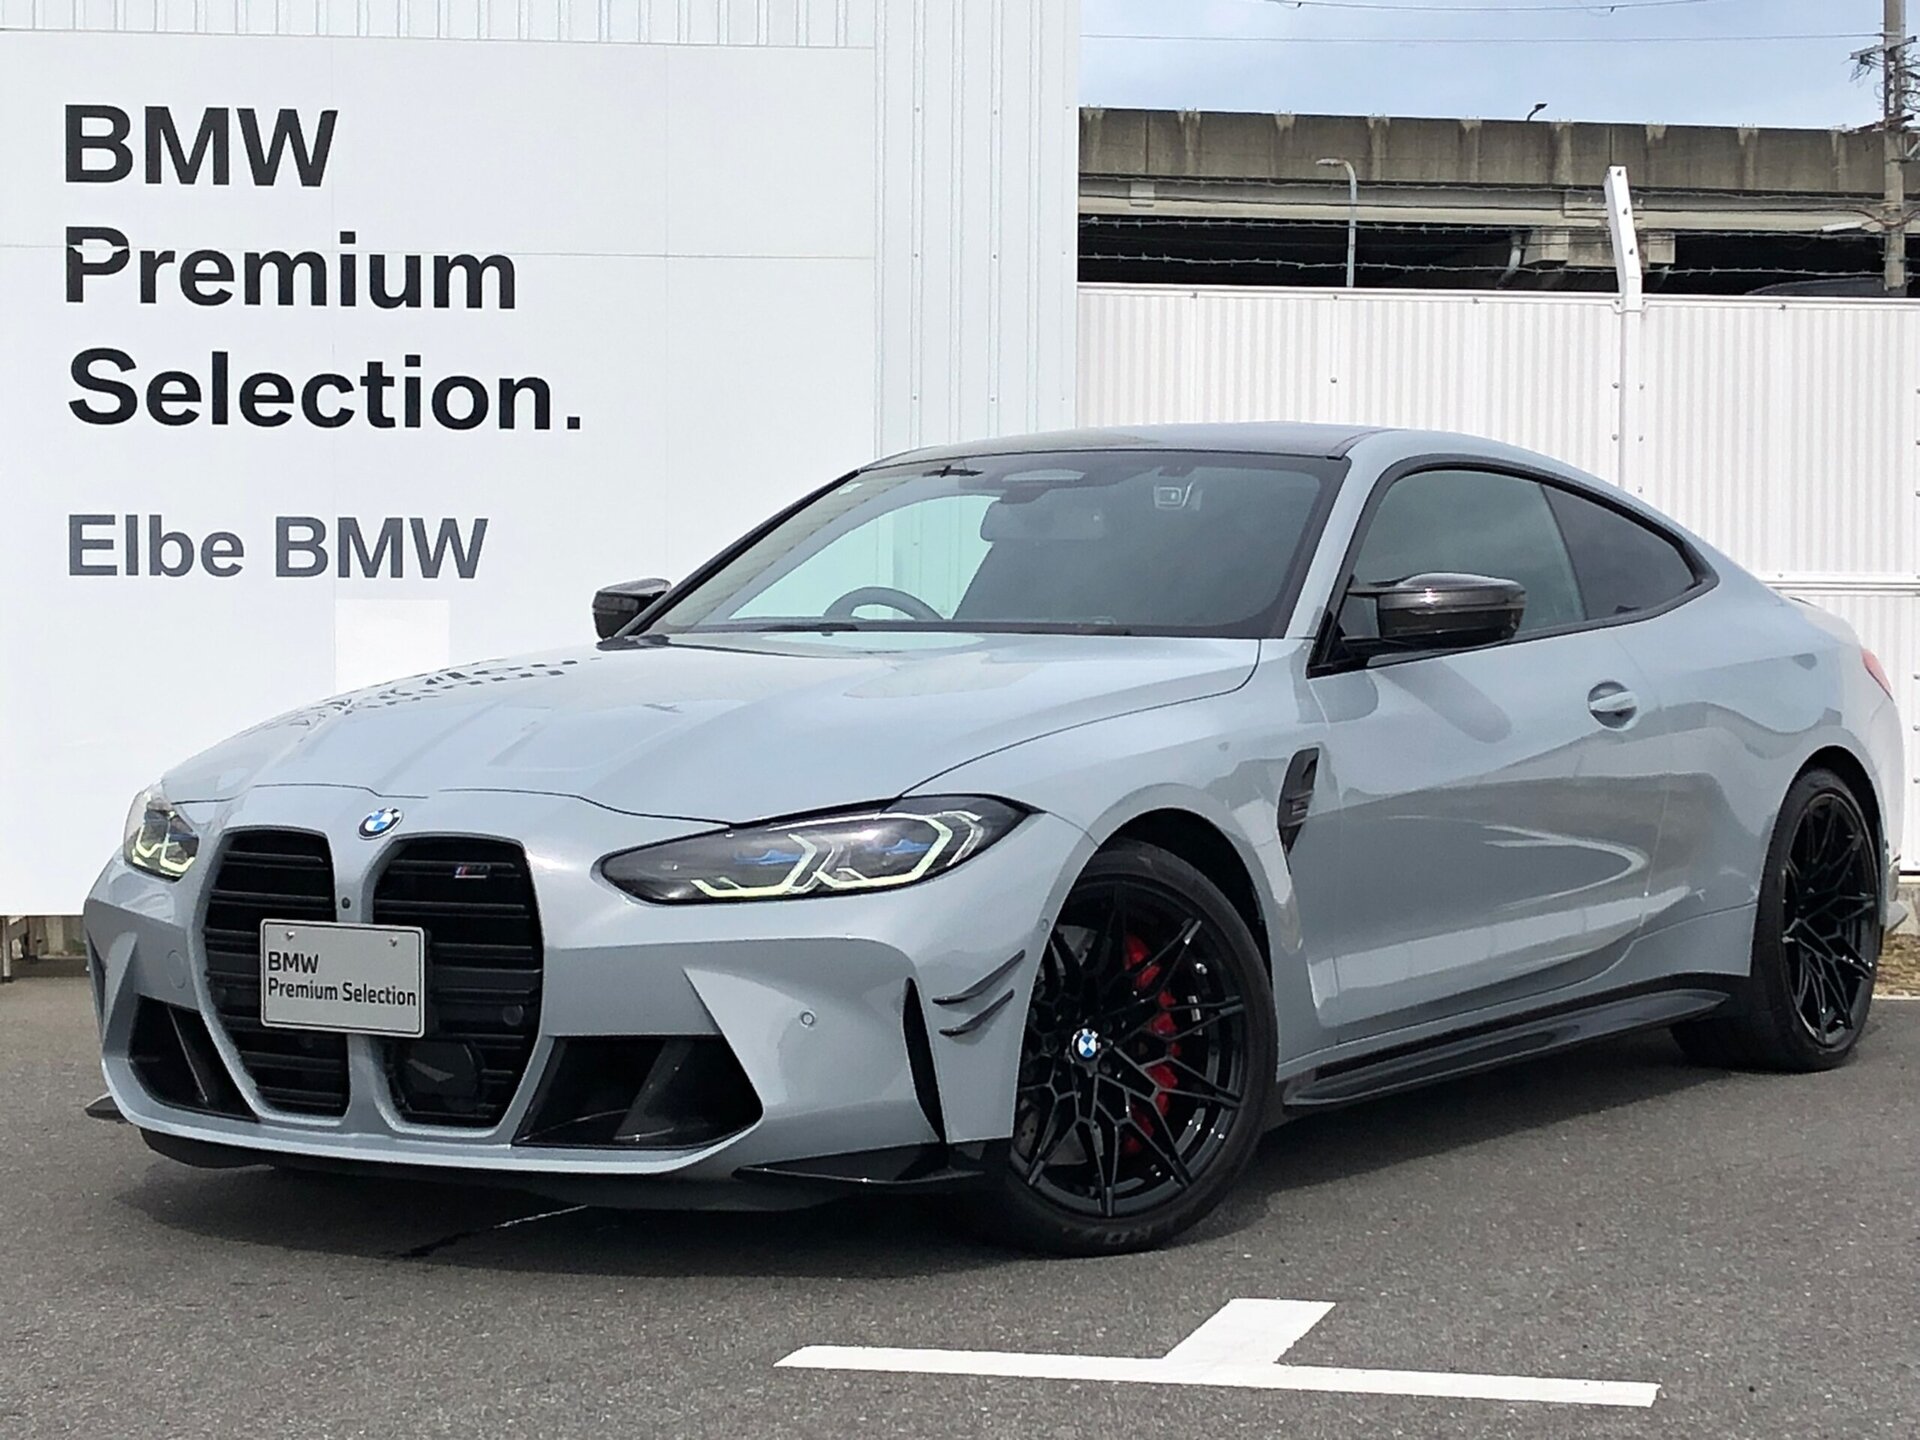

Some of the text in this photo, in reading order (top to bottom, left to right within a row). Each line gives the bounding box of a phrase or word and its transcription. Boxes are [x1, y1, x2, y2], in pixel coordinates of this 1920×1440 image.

[65, 104, 339, 188] BMW
[65, 226, 517, 310] Premium
[68, 347, 581, 431] Selection.
[69, 514, 489, 579] Elbe BMW
[268, 951, 319, 974] BMW
[268, 977, 416, 1006] Premium Selection
